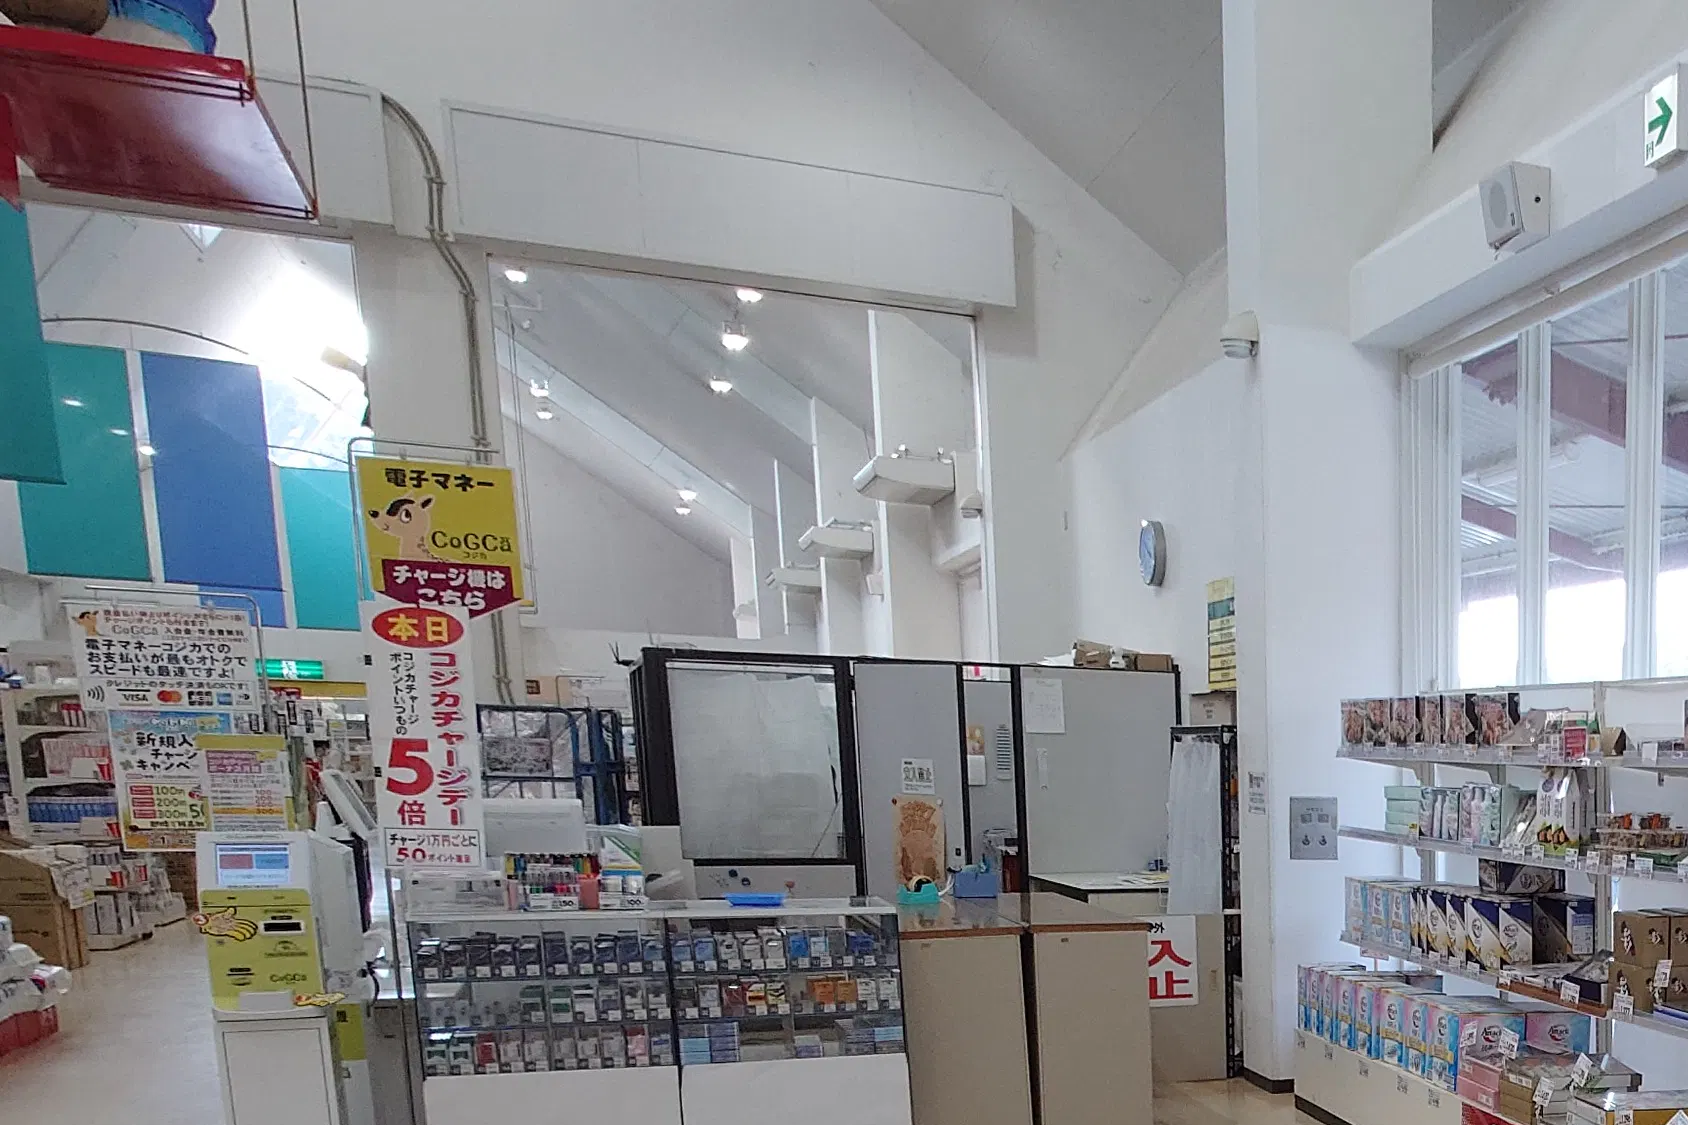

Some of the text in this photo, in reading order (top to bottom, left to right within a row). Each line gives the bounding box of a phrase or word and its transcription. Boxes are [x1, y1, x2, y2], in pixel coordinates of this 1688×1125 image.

[385, 468, 494, 492] 電子マネー
[393, 565, 506, 589] チャージ機は
[417, 588, 486, 610] こちら
[388, 613, 449, 642] 本日
[85, 639, 231, 652] 電子マネーコジカでの
[88, 652, 247, 666] お支払いが最もオトクで
[123, 694, 148, 702] VISA
[403, 653, 419, 725] コジカチャージ
[136, 732, 193, 748] 新規入
[429, 652, 468, 826] コジカチャージデー
[1148, 940, 1192, 967] 入
[1149, 971, 1193, 999] 止
